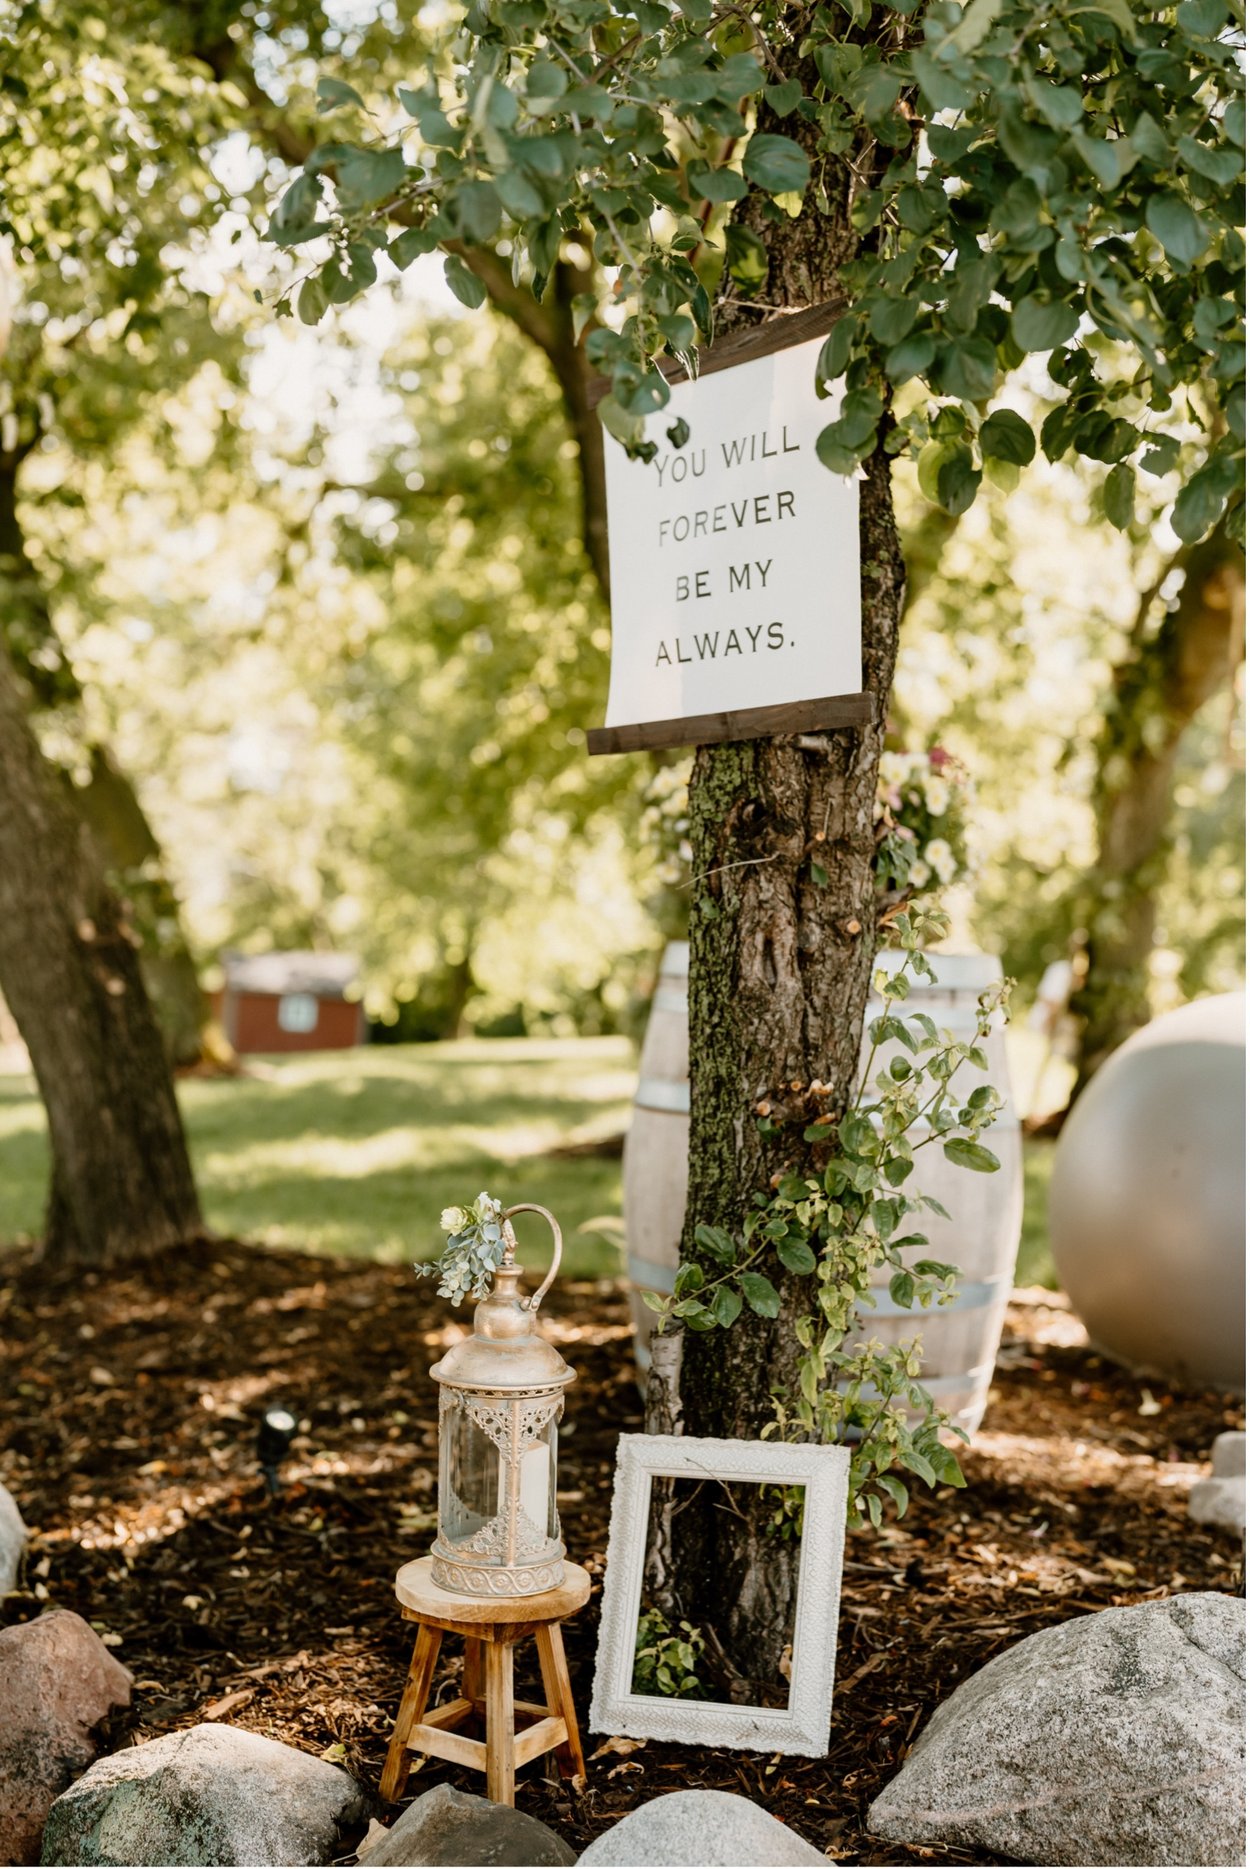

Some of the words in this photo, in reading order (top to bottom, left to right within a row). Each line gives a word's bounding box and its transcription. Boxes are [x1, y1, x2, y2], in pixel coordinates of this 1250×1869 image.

[653, 449, 706, 488] YOU
[720, 425, 800, 469] WILL
[658, 490, 797, 548] FOREVER
[676, 570, 711, 602] BE
[729, 559, 773, 593] MY
[655, 621, 796, 668] ALWAYS.
